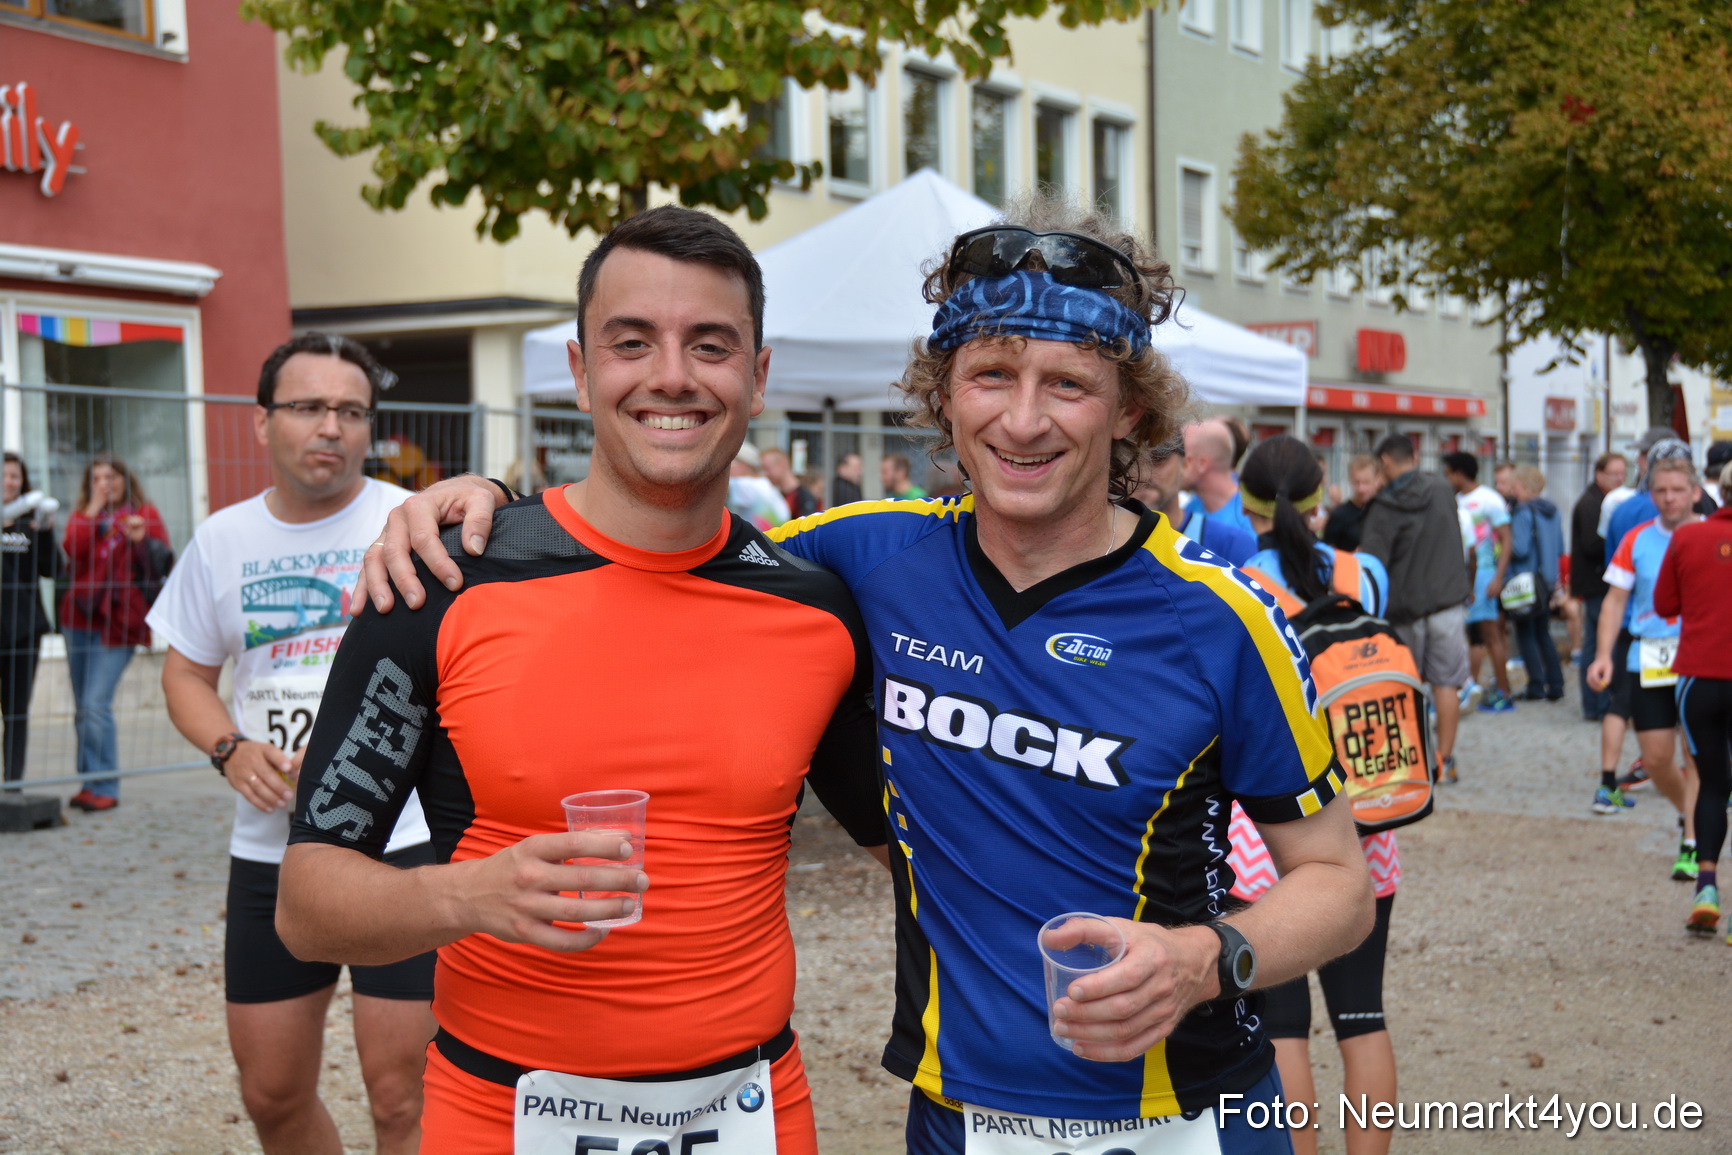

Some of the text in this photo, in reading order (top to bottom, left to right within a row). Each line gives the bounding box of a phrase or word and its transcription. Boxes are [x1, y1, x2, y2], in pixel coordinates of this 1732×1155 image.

[0, 82, 80, 197] ily
[241, 548, 368, 578] BLACKMORE
[739, 554, 780, 567] adidas
[890, 631, 985, 675] TEAM
[267, 707, 314, 753] 52
[1344, 693, 1407, 734] PART
[883, 676, 1124, 788] BOCK
[1344, 725, 1404, 759] OF A
[1351, 746, 1418, 778] LEGEND
[523, 1094, 727, 1127] PARTL Neumarkt
[971, 1111, 1045, 1139] PARTL
